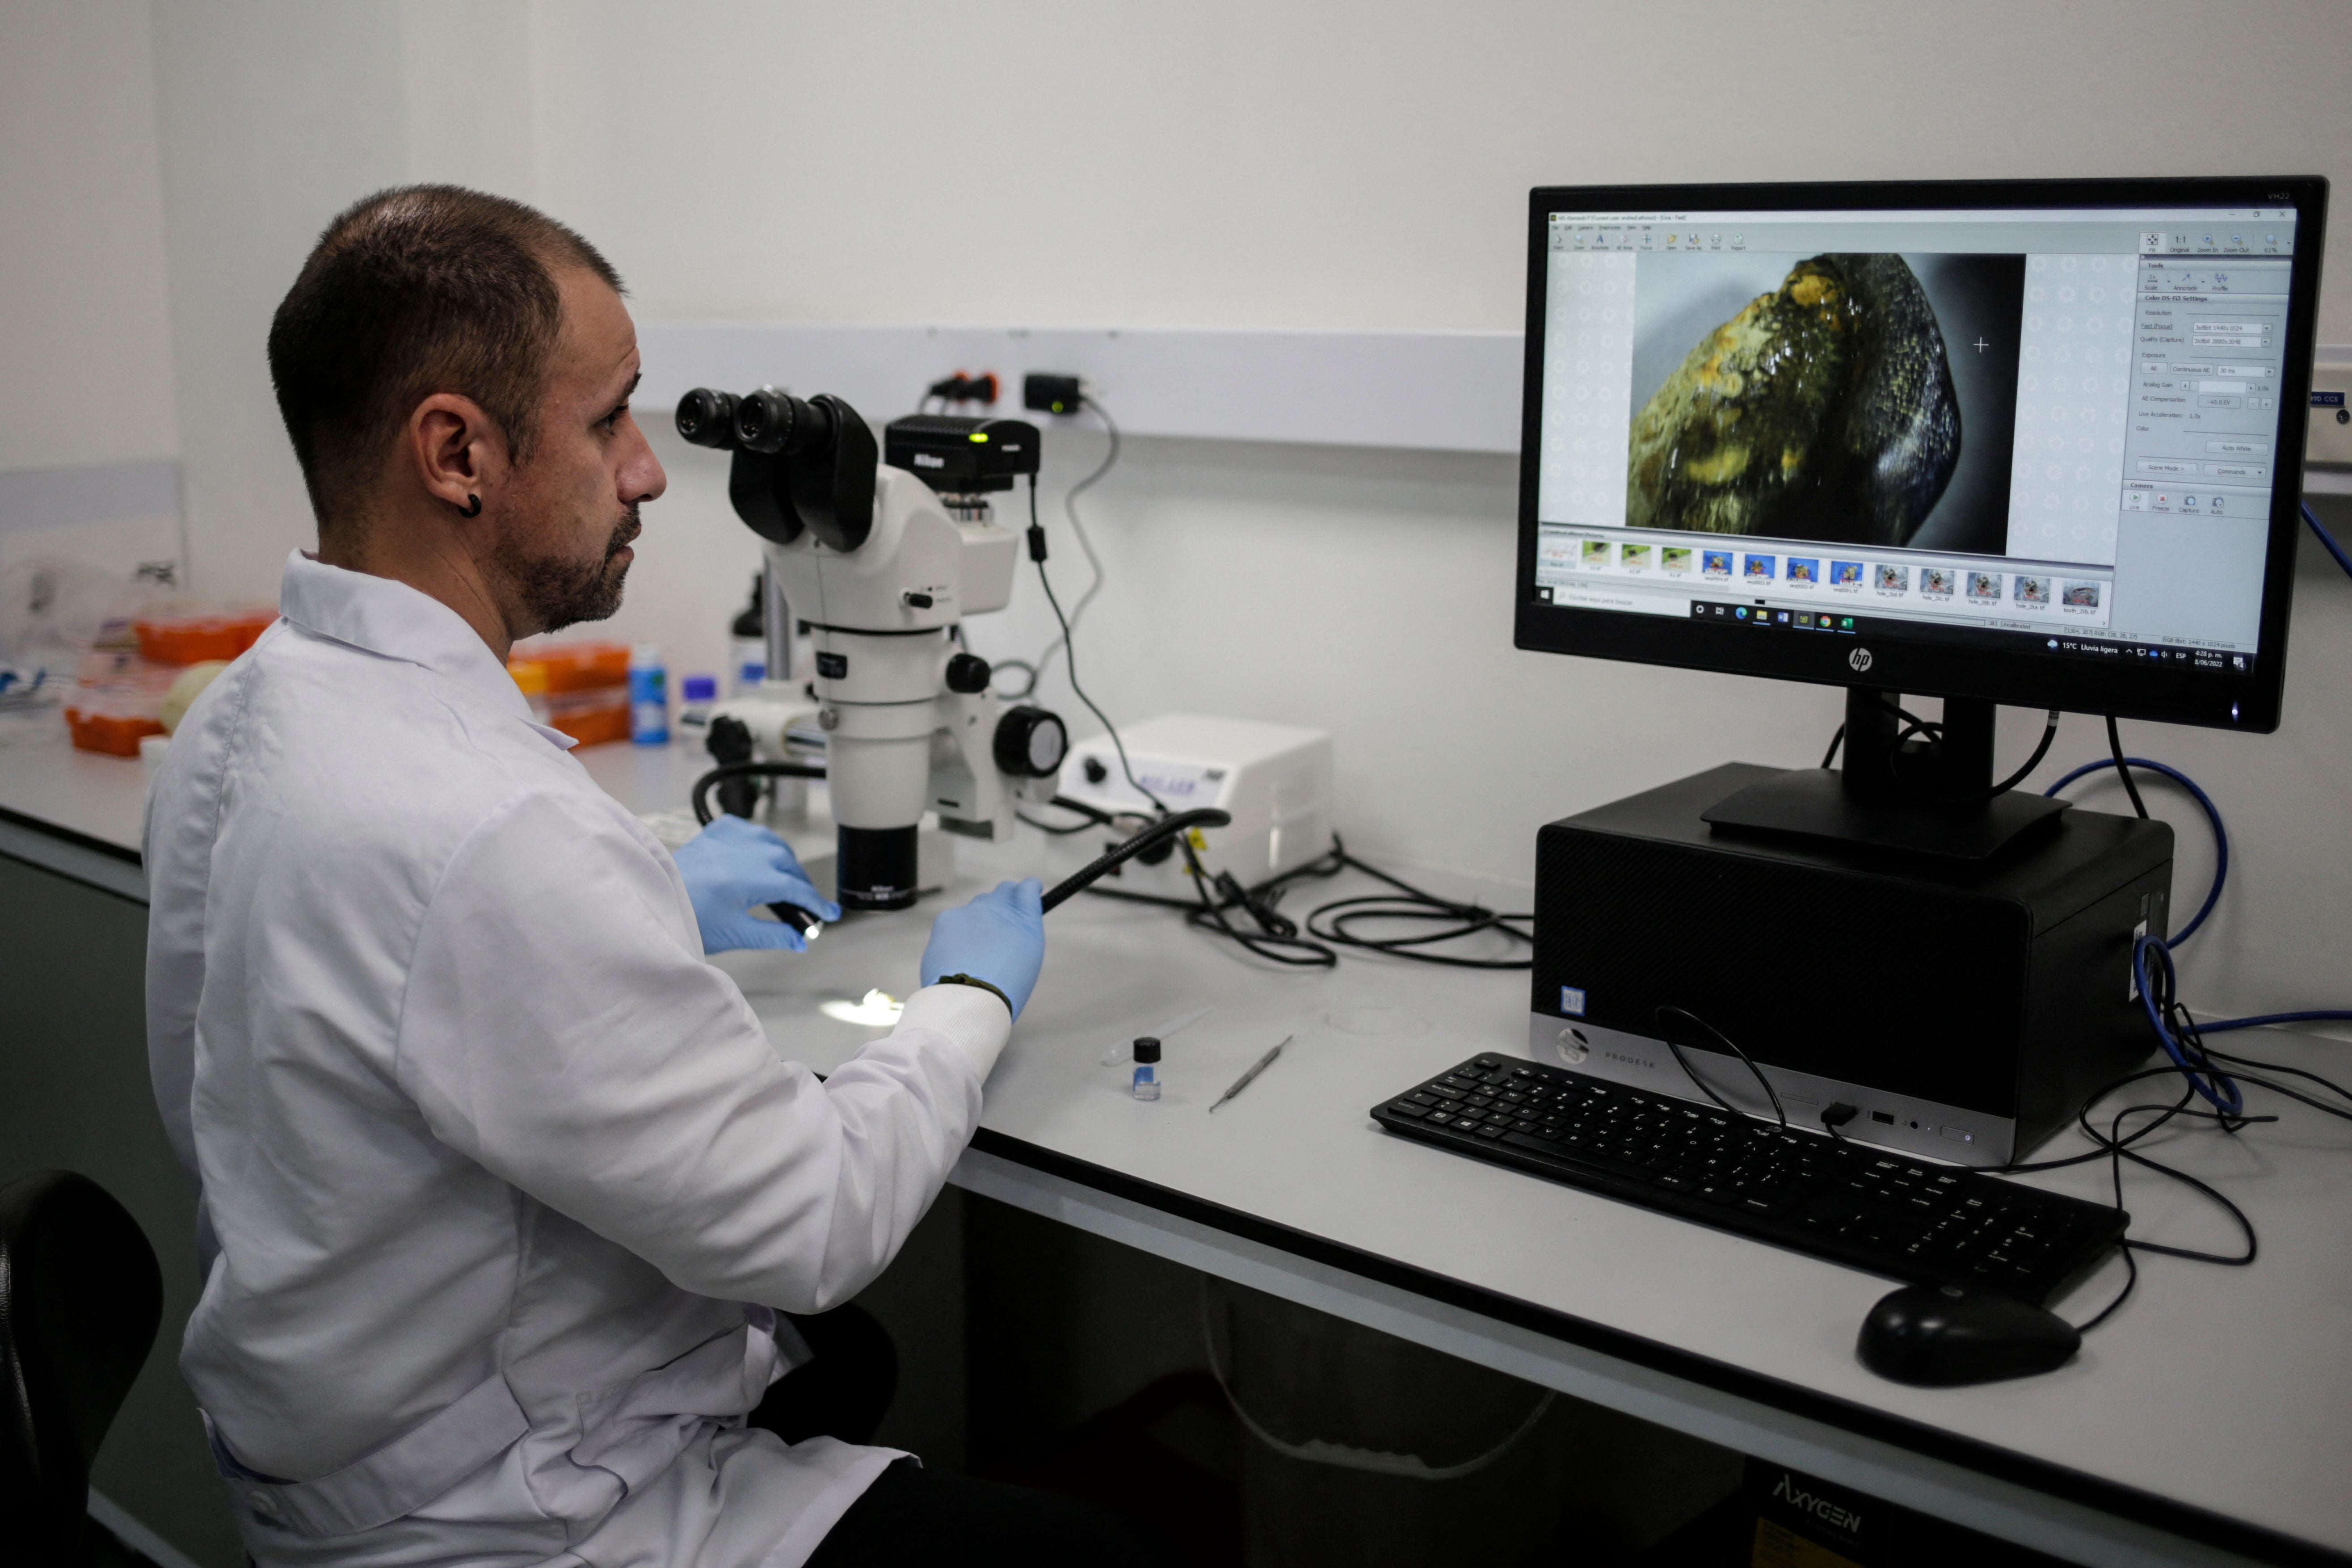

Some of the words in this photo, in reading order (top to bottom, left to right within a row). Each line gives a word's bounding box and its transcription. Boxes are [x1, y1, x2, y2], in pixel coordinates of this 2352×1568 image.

[914, 453, 945, 468] Nikon
[2001, 622, 2031, 630] Uncalibrated
[2100, 646, 2118, 654] ligera
[1850, 648, 1871, 671] hp
[2195, 659, 2223, 667] 8/06/2022
[1605, 1051, 1655, 1068] PRODESK
[1772, 1473, 1861, 1533] AXYGEN
